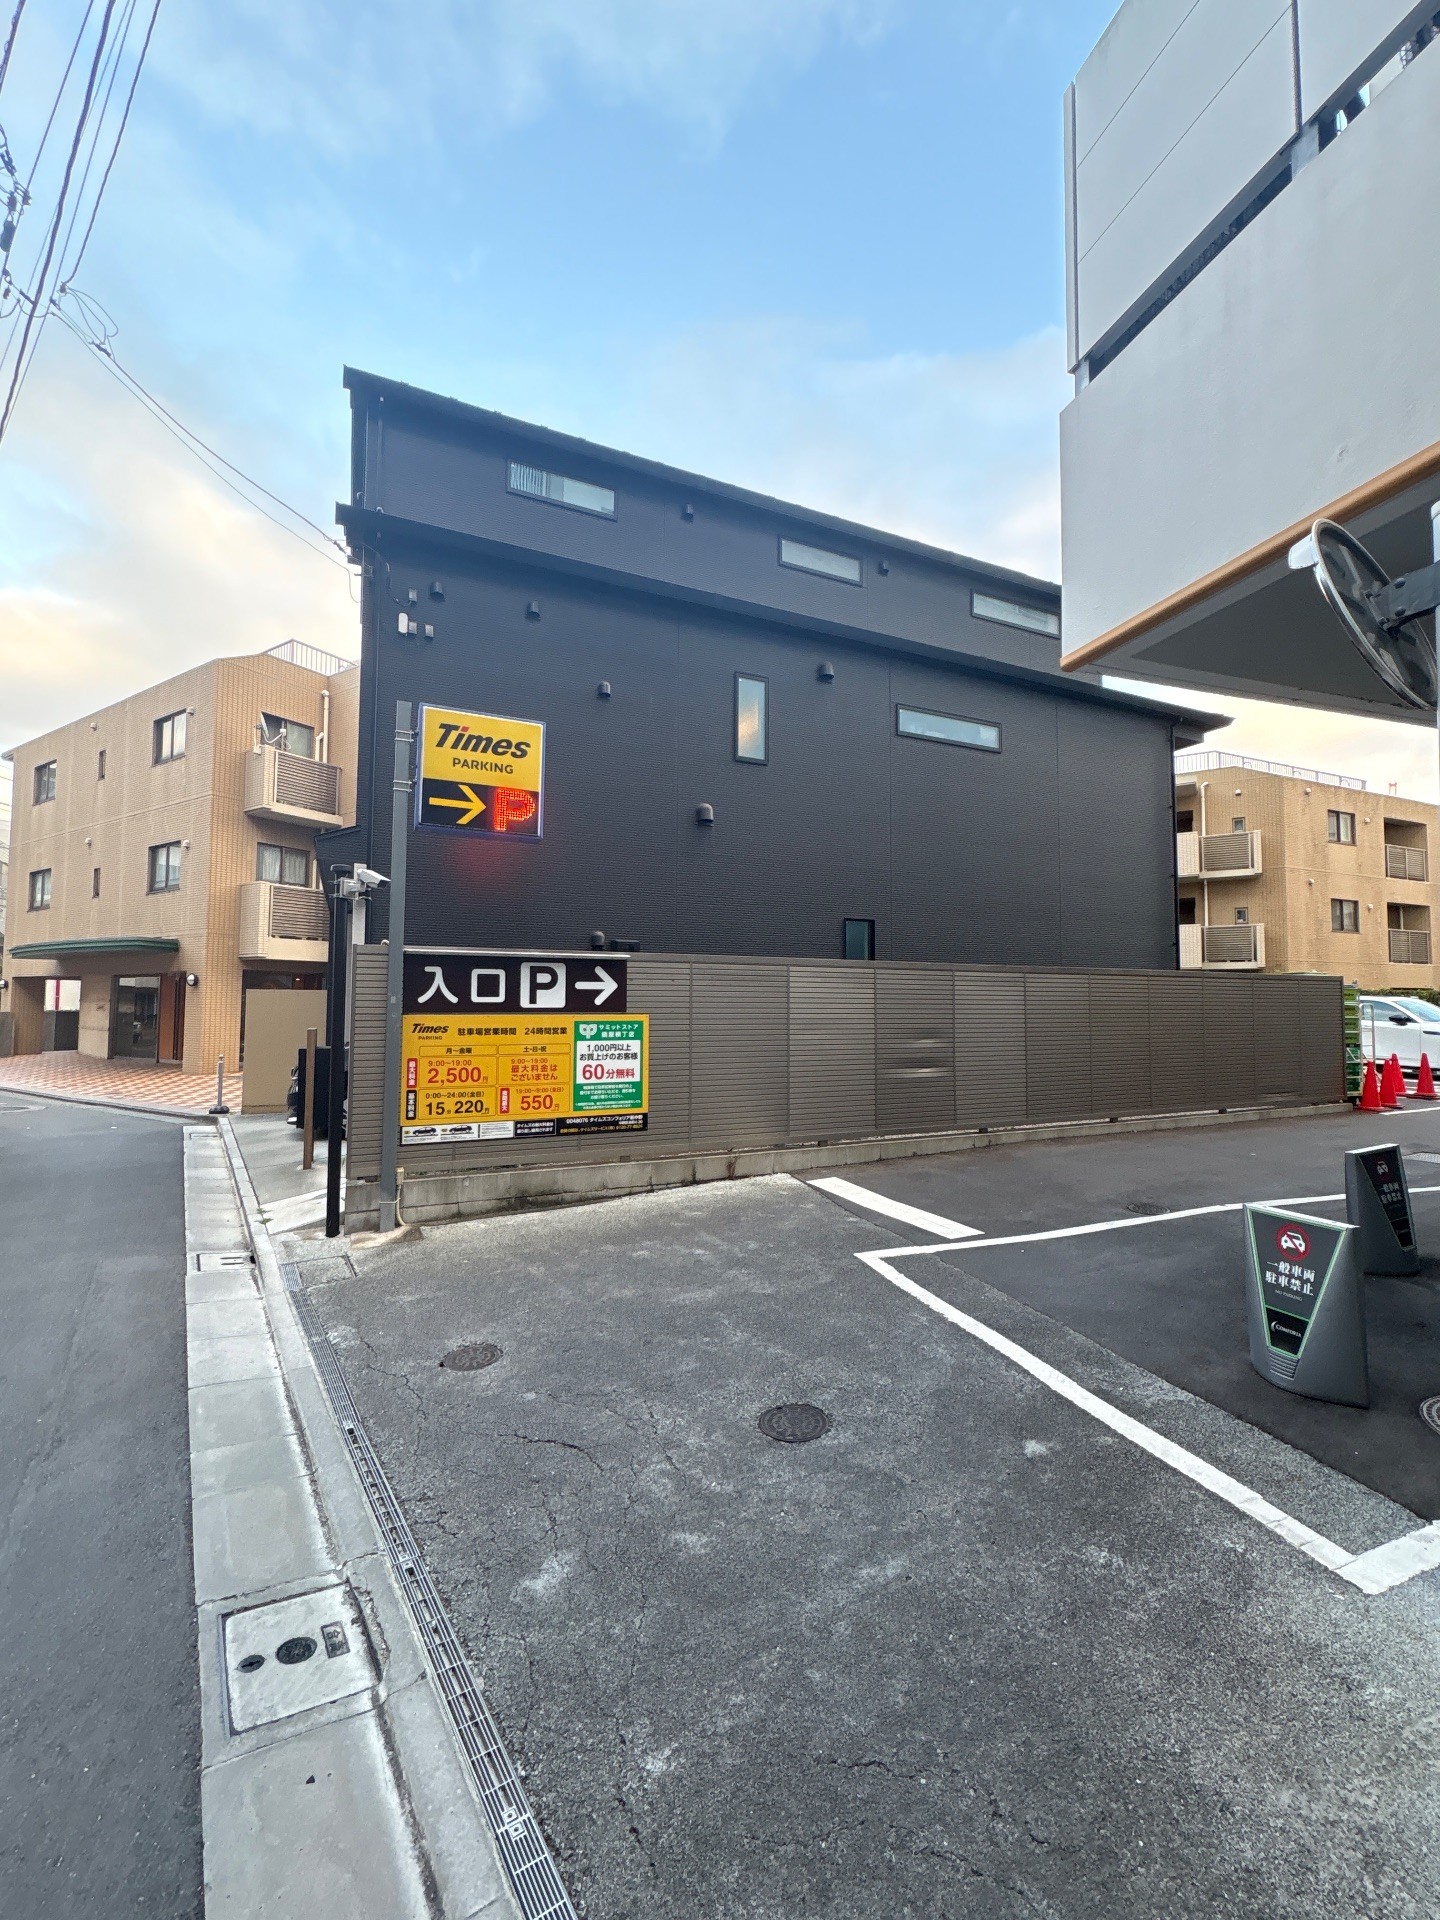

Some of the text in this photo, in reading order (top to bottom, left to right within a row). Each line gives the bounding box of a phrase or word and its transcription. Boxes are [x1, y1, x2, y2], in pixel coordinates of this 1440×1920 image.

[435, 722, 531, 759] Times
[452, 757, 514, 774] PARKING
[493, 787, 536, 831] P
[417, 966, 506, 1003] 入口
[411, 1023, 449, 1034] Times
[457, 1027, 568, 1036] 駐車場営業時間 24時間営業
[586, 1043, 631, 1052] 1,000円以上
[579, 1053, 638, 1061] お買上げのお客様
[511, 1064, 558, 1073] 最大料金は
[511, 1073, 558, 1081] ございません
[582, 1063, 635, 1080] 60分無料
[1267, 1260, 1316, 1282] 一般車両
[1265, 1271, 1314, 1296] 駐車禁止
